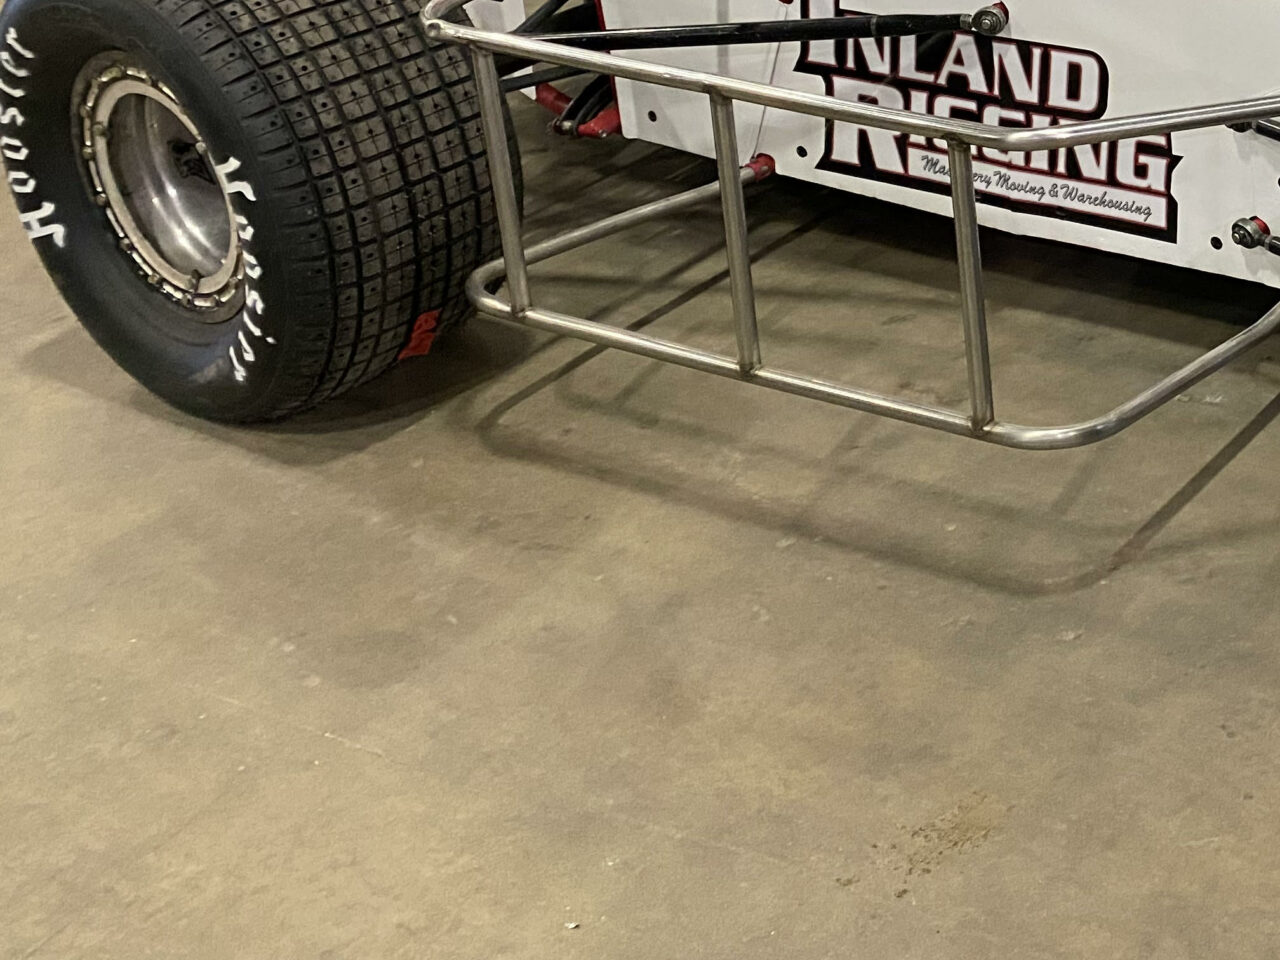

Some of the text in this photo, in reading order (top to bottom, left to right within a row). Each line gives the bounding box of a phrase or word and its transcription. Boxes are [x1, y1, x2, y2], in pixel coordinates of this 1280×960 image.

[993, 170, 1046, 201] Moving
[1050, 183, 1059, 198] &
[1060, 183, 1153, 223] Warehousing
